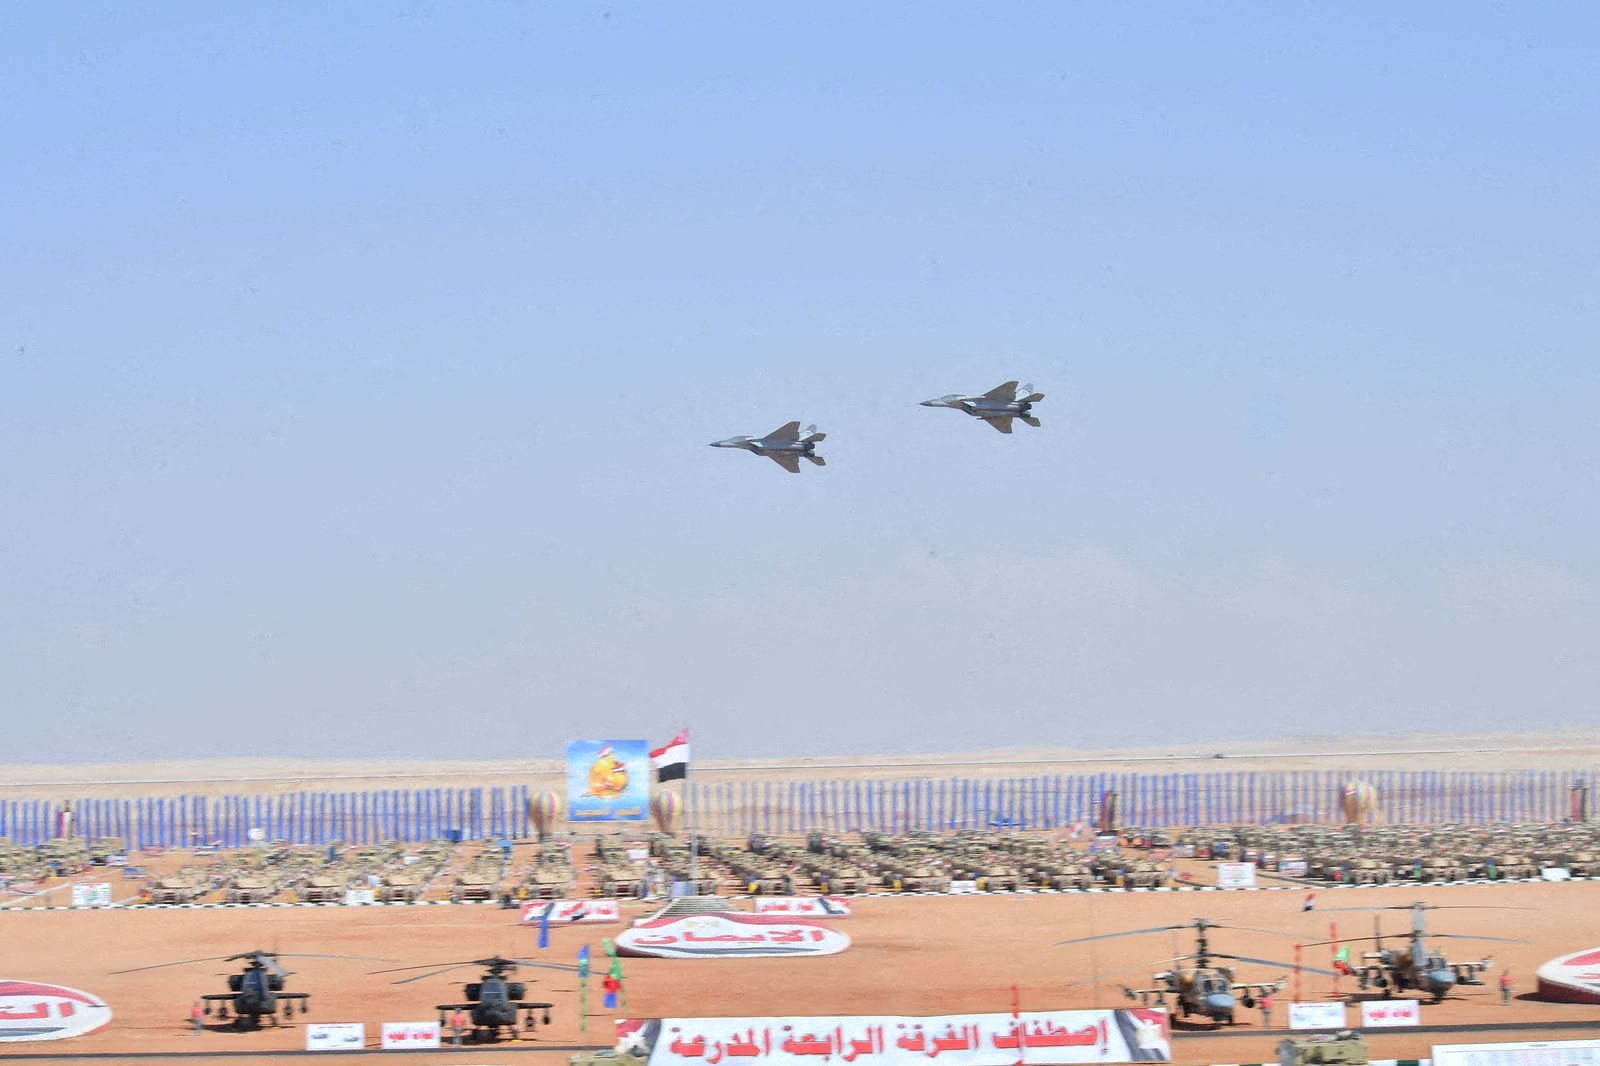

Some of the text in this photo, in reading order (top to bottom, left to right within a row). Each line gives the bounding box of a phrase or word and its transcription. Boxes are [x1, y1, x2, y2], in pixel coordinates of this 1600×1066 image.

[668, 1025, 771, 1064] المدرعة
[781, 1024, 885, 1062] الرابعة
[896, 1023, 979, 1058] الفرقة
